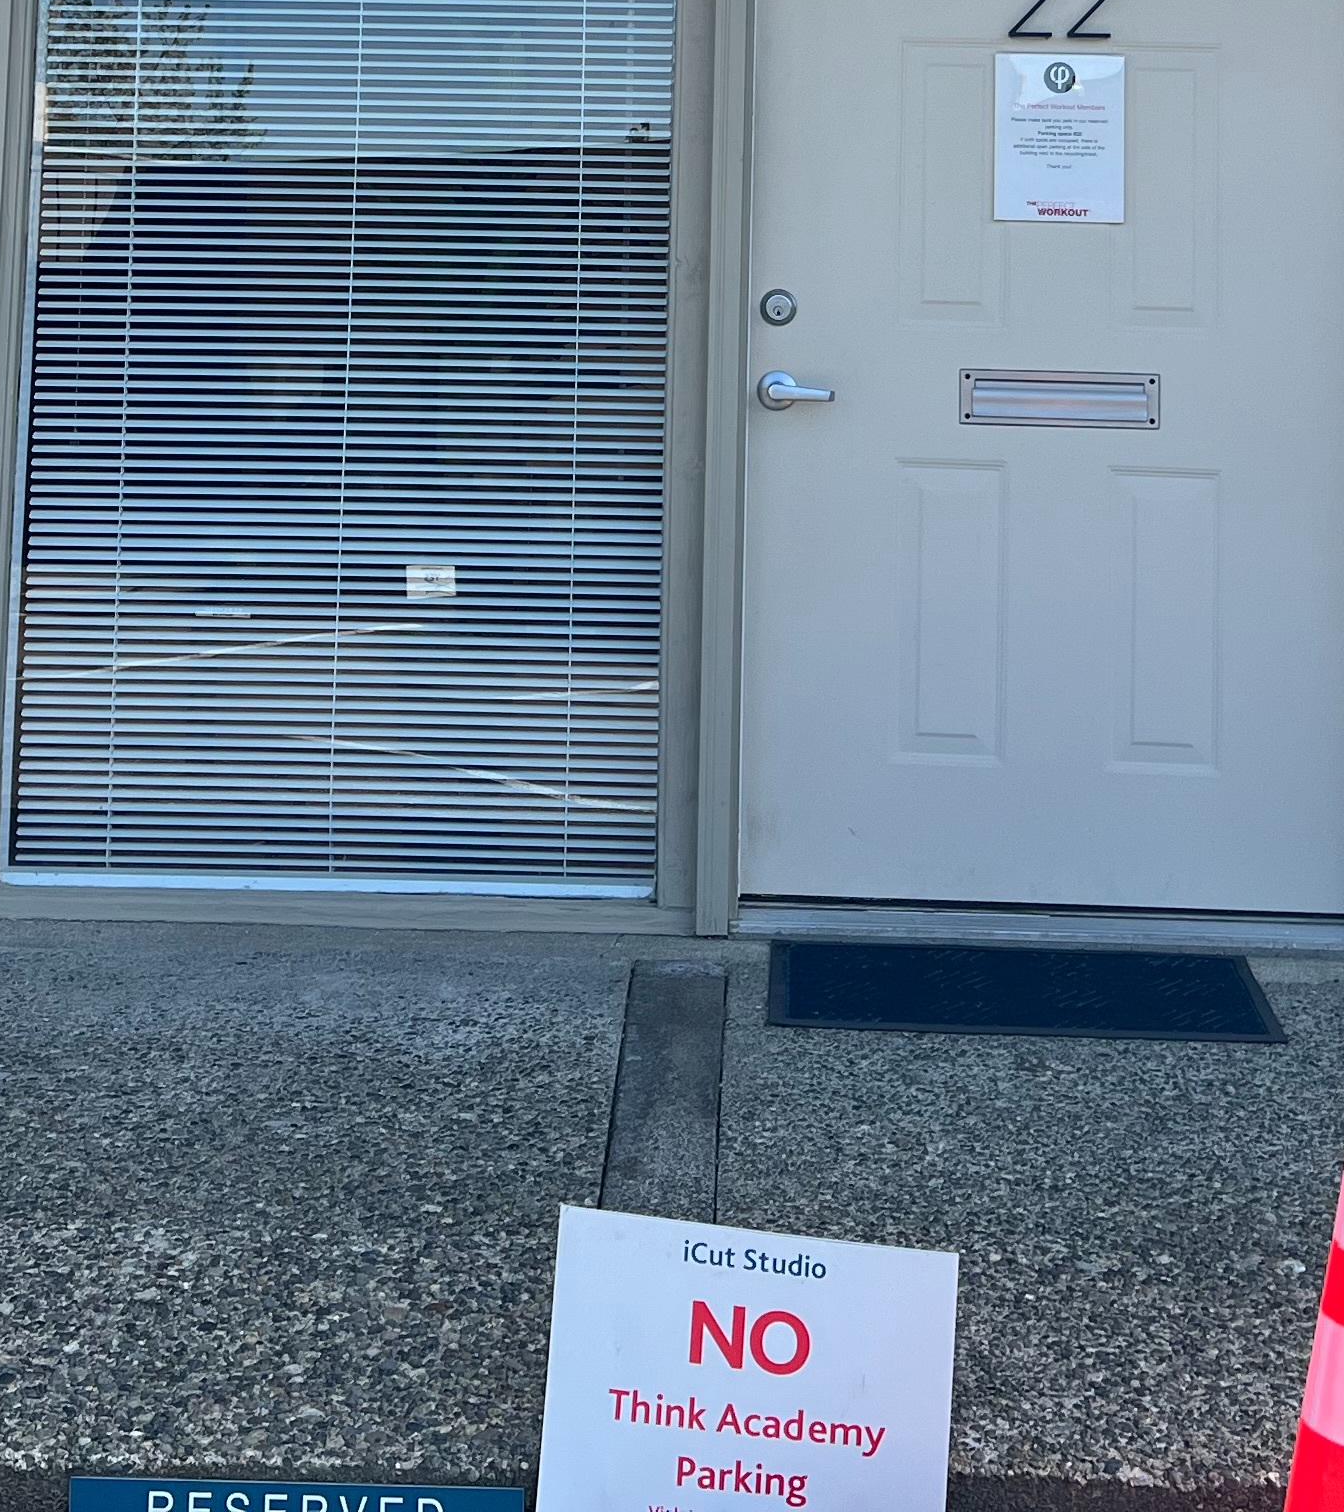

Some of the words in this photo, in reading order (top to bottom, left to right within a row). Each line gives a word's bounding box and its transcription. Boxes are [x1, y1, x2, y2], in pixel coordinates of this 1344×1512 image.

[1036, 201, 1076, 209] PERFECT
[1038, 208, 1089, 217] WORKOUT
[683, 1240, 735, 1268] iCut
[743, 1249, 826, 1279] Studio
[689, 1300, 811, 1376] NO
[609, 1388, 706, 1431] Think
[716, 1403, 886, 1457] Academy
[676, 1455, 808, 1507] Parking
